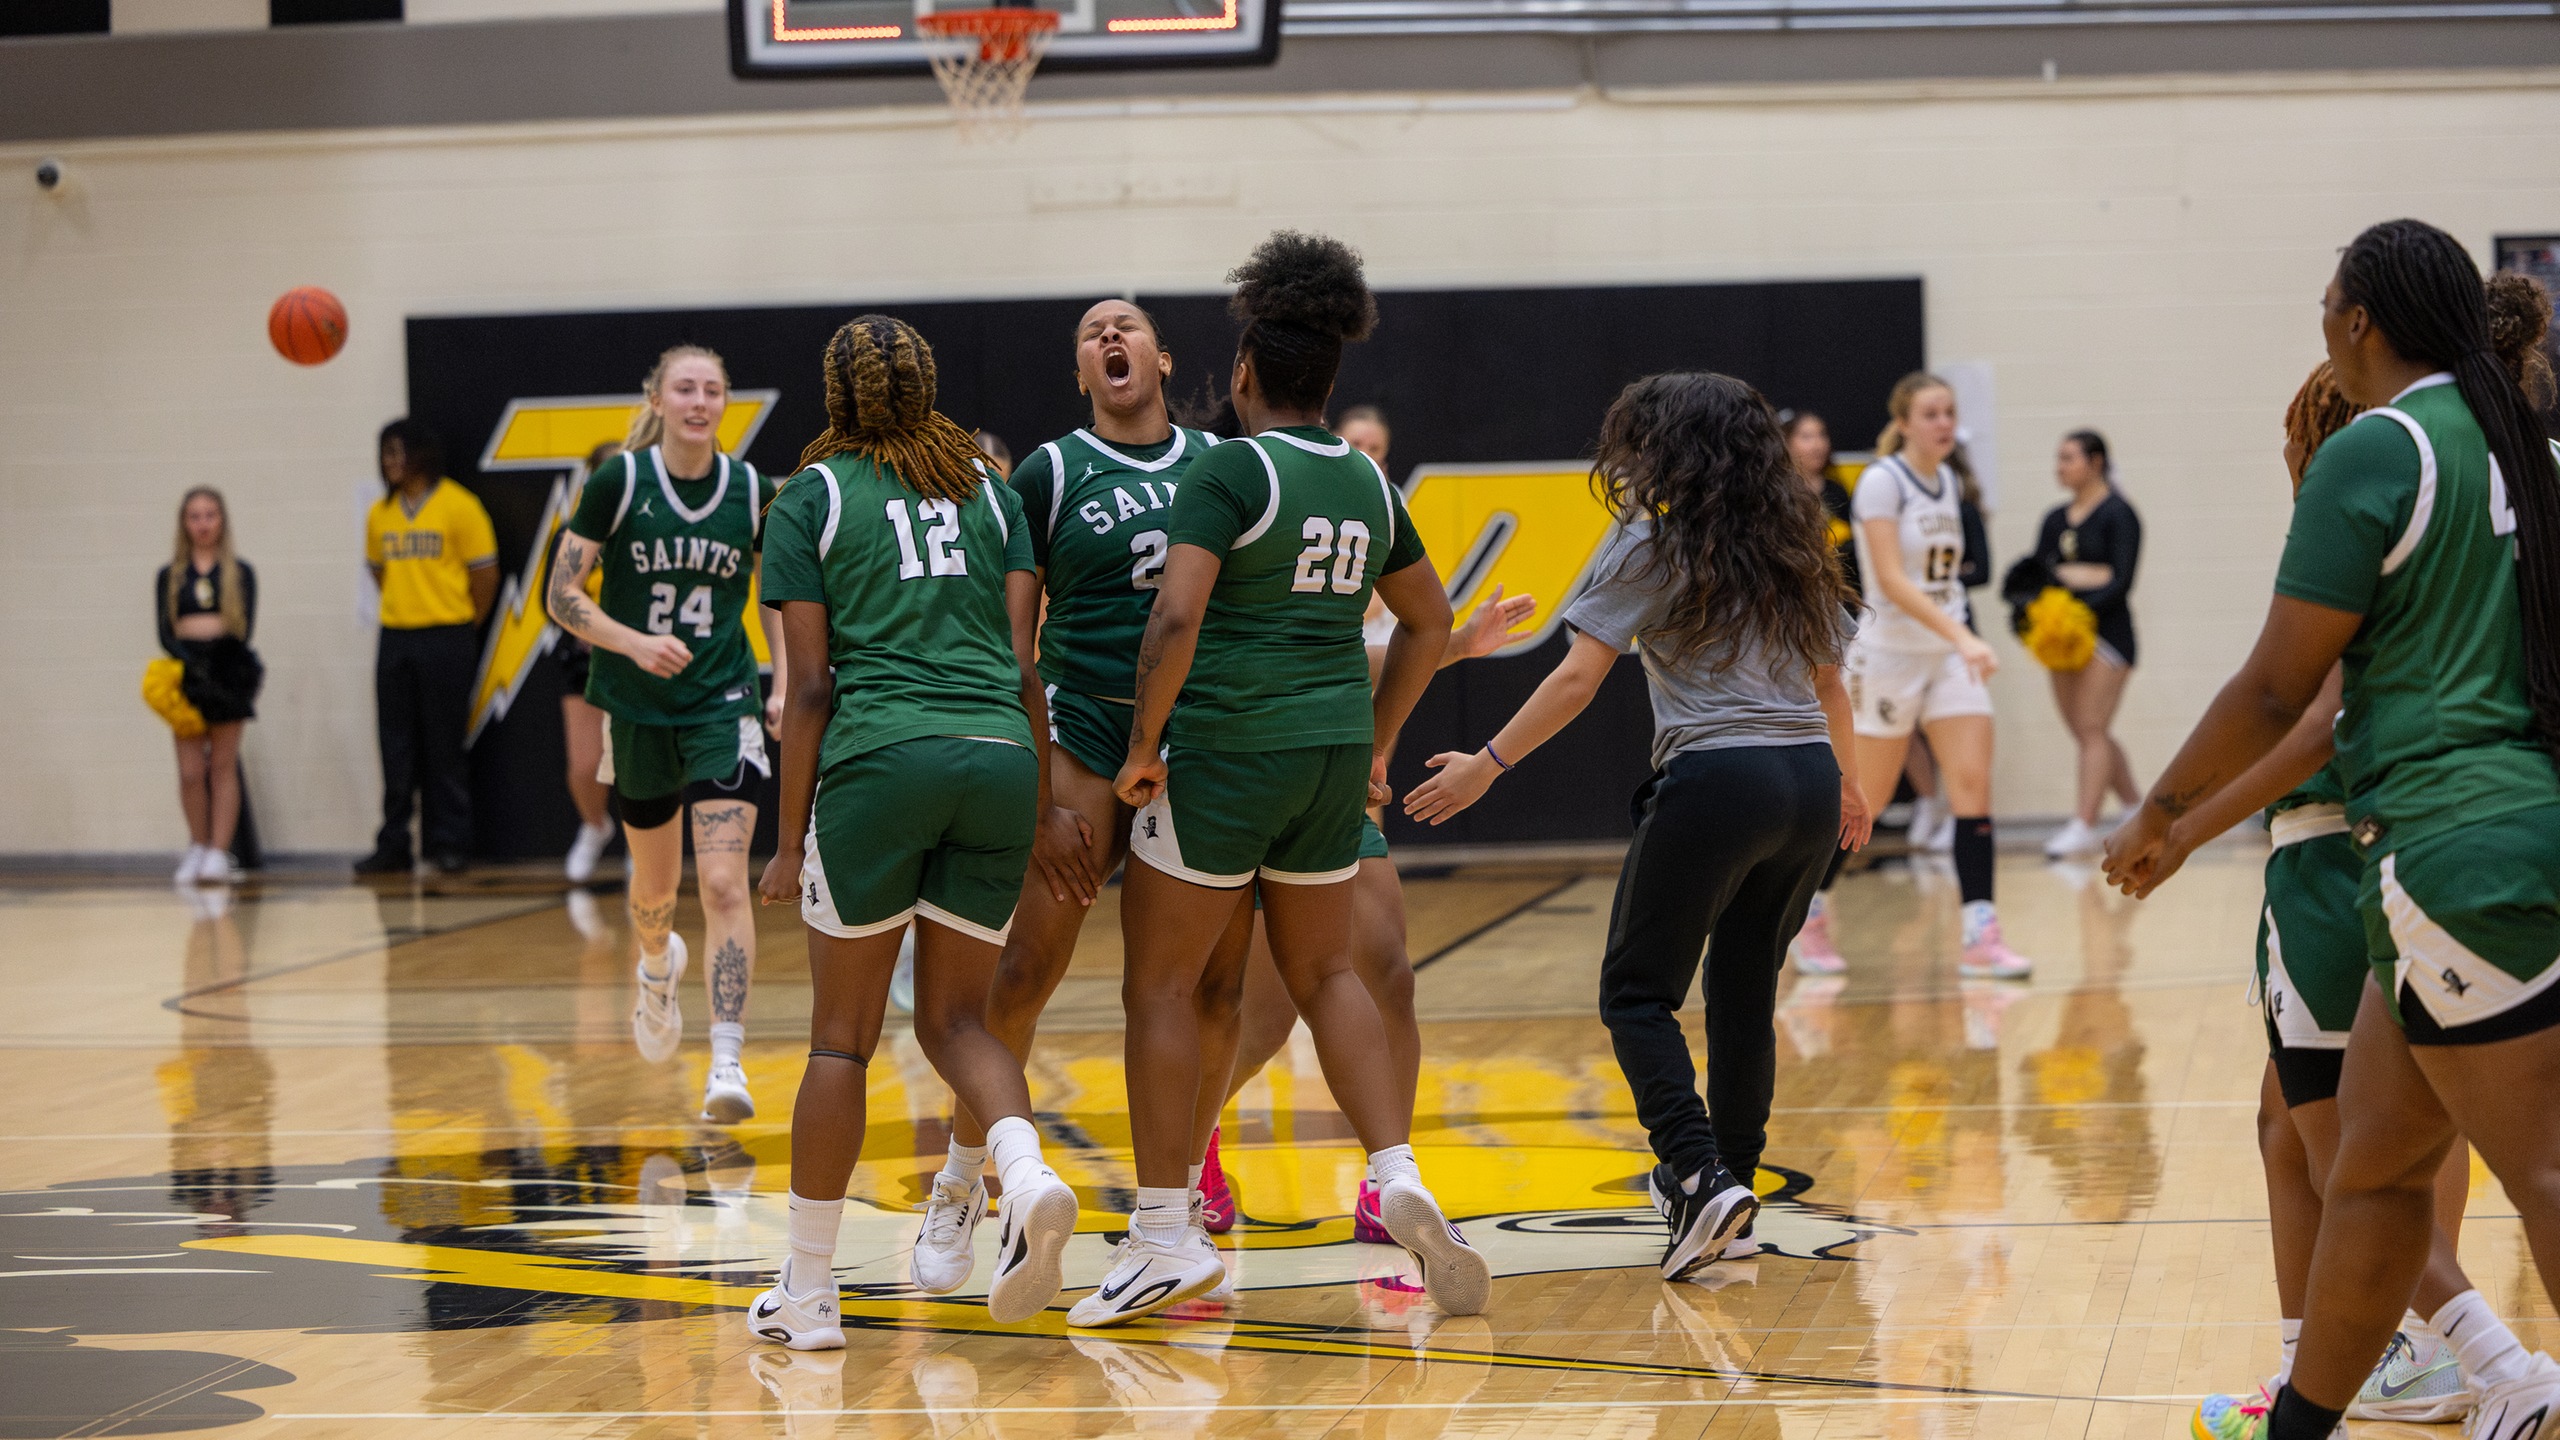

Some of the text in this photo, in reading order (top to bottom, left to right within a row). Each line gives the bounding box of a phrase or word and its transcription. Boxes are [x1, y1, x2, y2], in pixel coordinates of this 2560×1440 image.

[630, 536, 741, 579] SAINTS
[885, 497, 968, 581] 12
[1291, 515, 1370, 596] 20
[647, 581, 714, 638] 24
